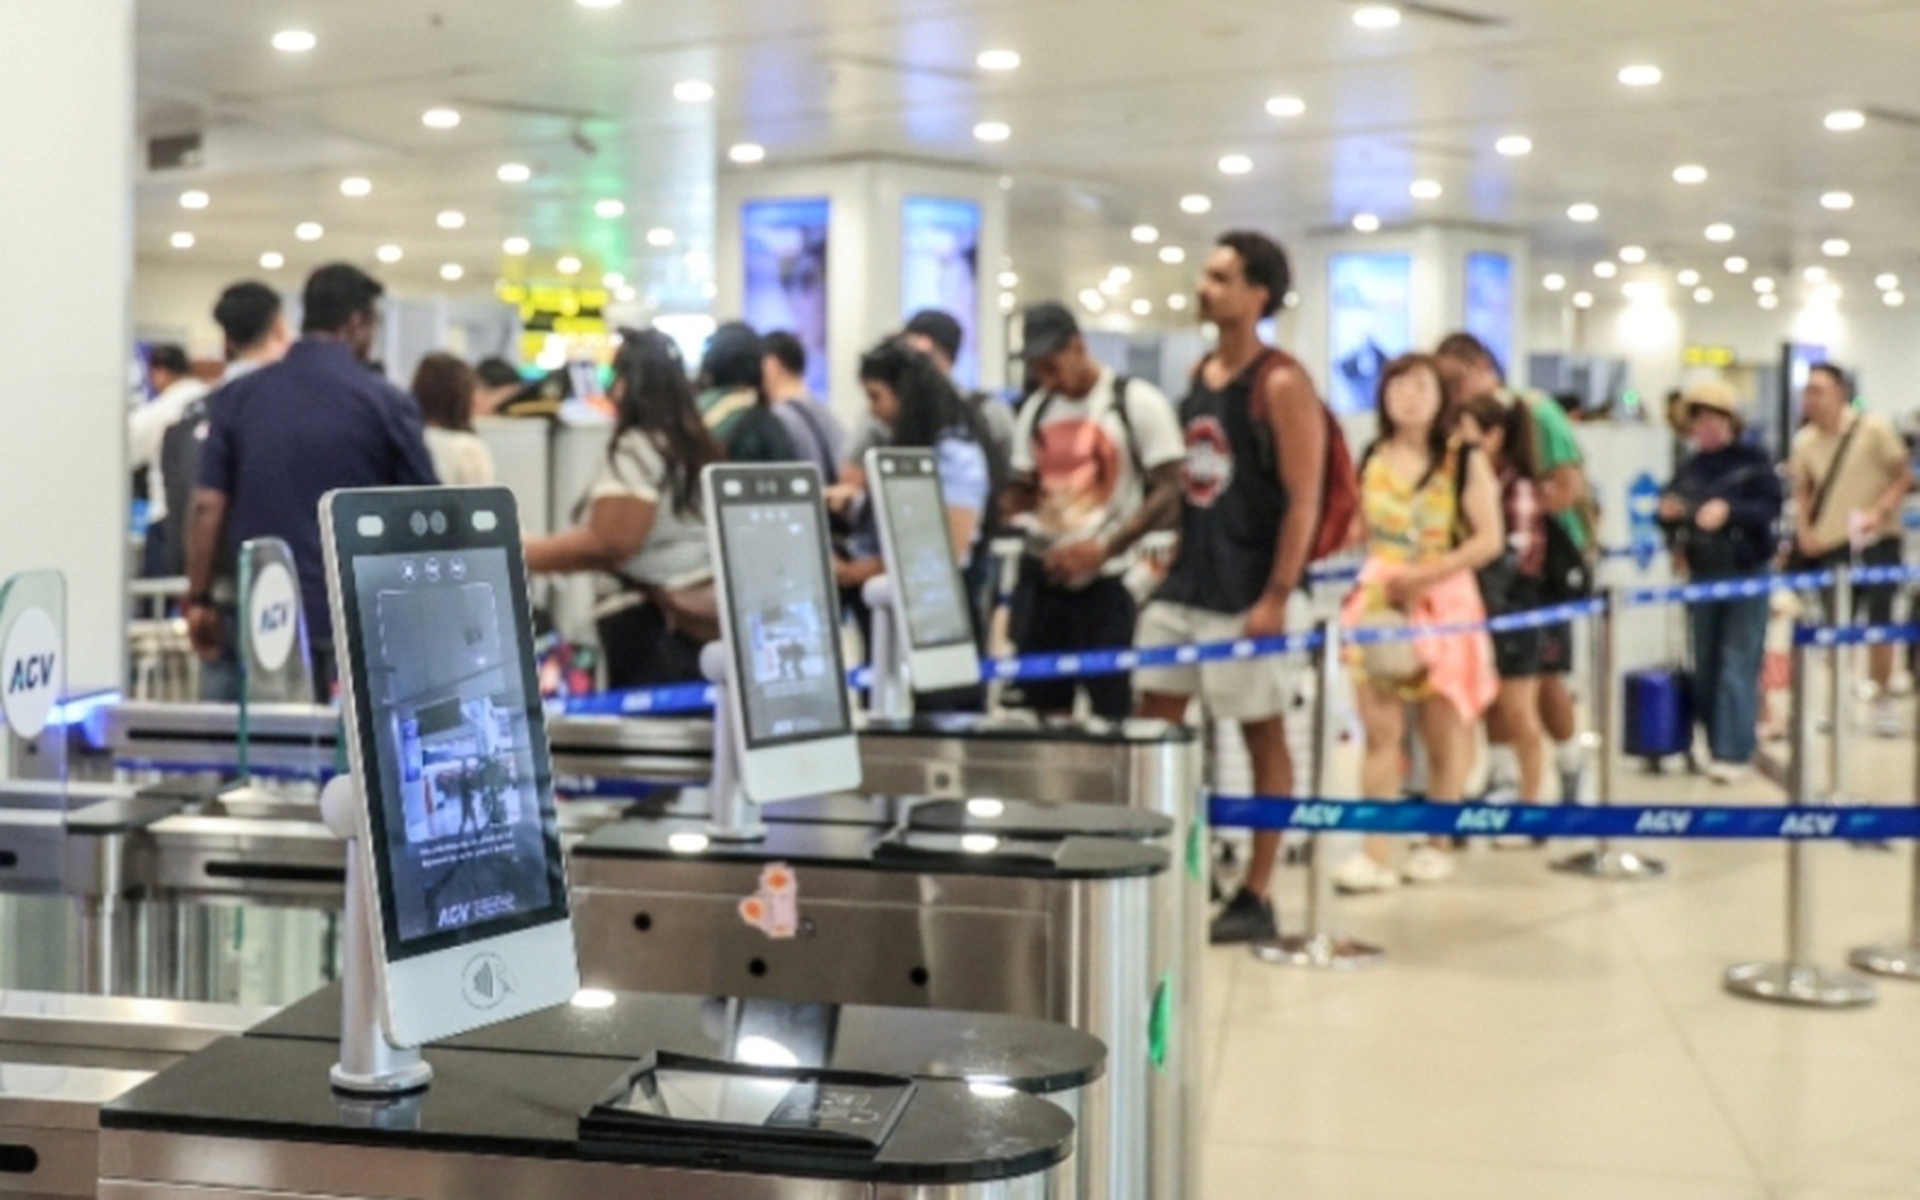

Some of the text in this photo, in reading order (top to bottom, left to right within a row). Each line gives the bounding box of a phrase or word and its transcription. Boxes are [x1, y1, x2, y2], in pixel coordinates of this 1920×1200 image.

[8, 653, 55, 694] ACV
[1289, 804, 1838, 836] ACV ACV ACV ACV
[438, 902, 470, 927] ACV
